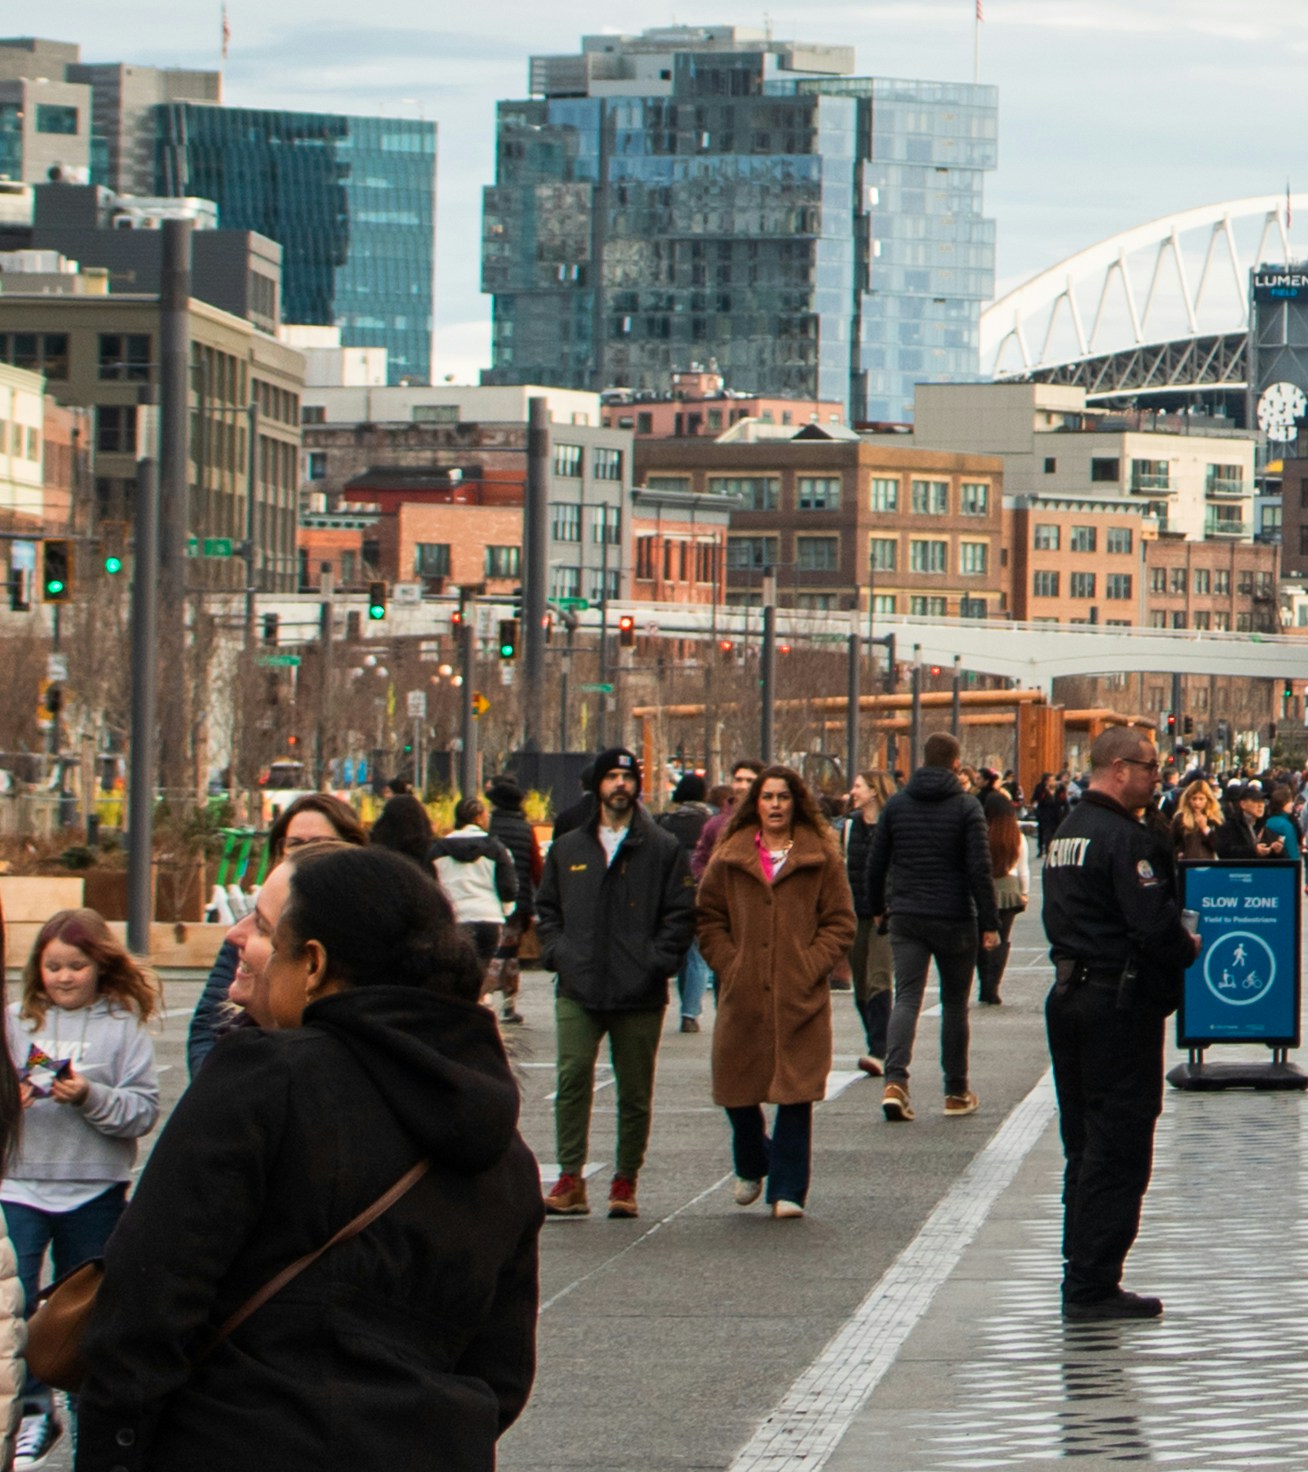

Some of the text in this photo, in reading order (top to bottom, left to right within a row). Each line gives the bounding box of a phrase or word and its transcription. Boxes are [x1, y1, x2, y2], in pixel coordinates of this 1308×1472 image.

[1270, 289, 1298, 297] FIELD
[1202, 897, 1279, 908] SLOW ZONE
[1233, 916, 1278, 924] Pedestrians
